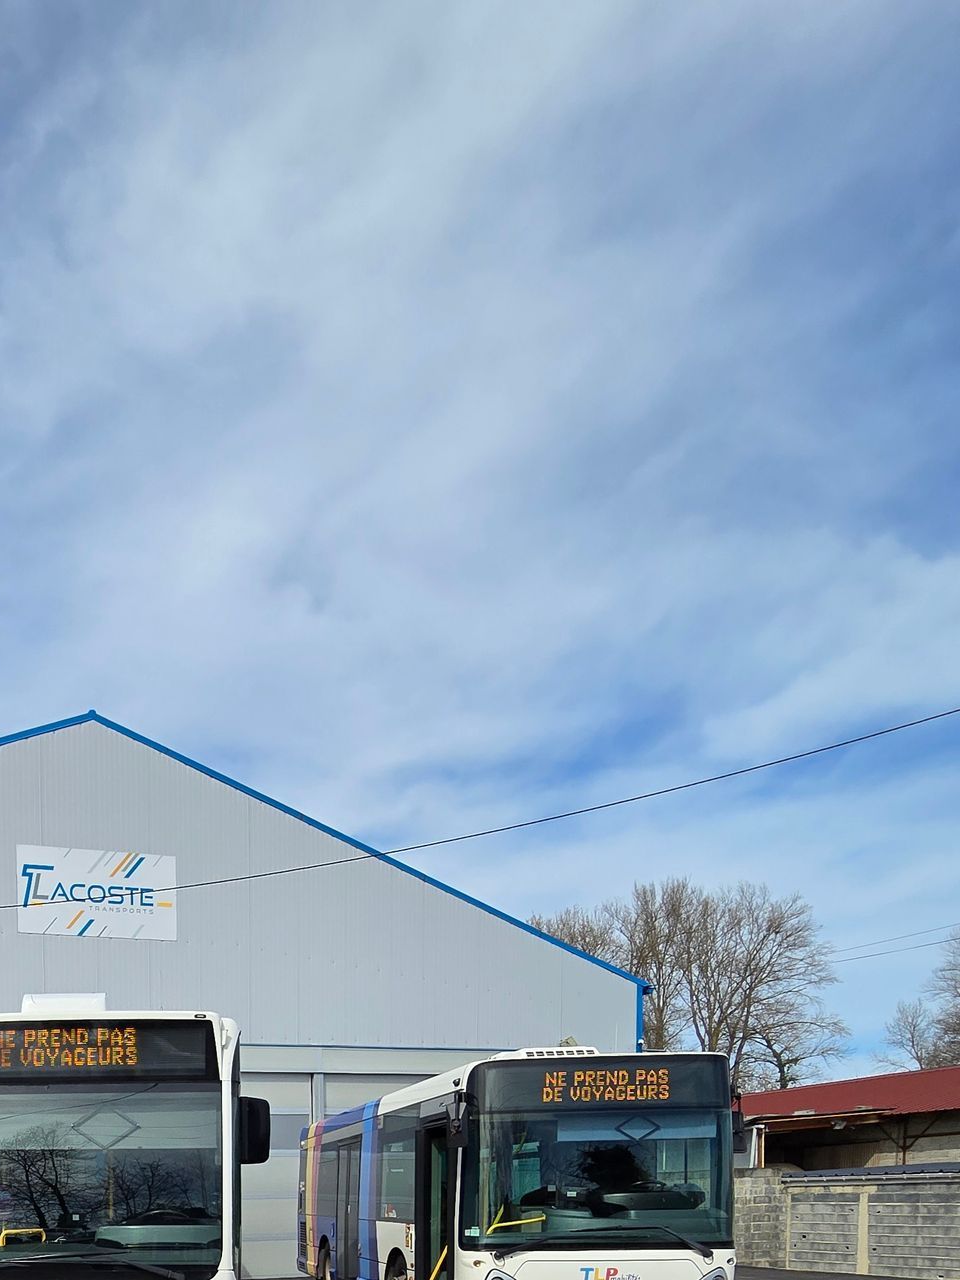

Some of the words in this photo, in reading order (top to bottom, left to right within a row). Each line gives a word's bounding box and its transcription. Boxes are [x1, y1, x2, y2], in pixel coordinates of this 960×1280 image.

[89, 905, 154, 915] TRANSPORTS
[24, 1028, 89, 1048] PREND
[97, 1027, 136, 1047] PAS
[20, 1047, 138, 1068] VOYAGEURS
[545, 1071, 567, 1087] NE
[574, 1069, 629, 1086] PREND
[636, 1068, 669, 1085] PAS
[542, 1087, 563, 1103] DE
[570, 1084, 670, 1102] VOYAGEURS
